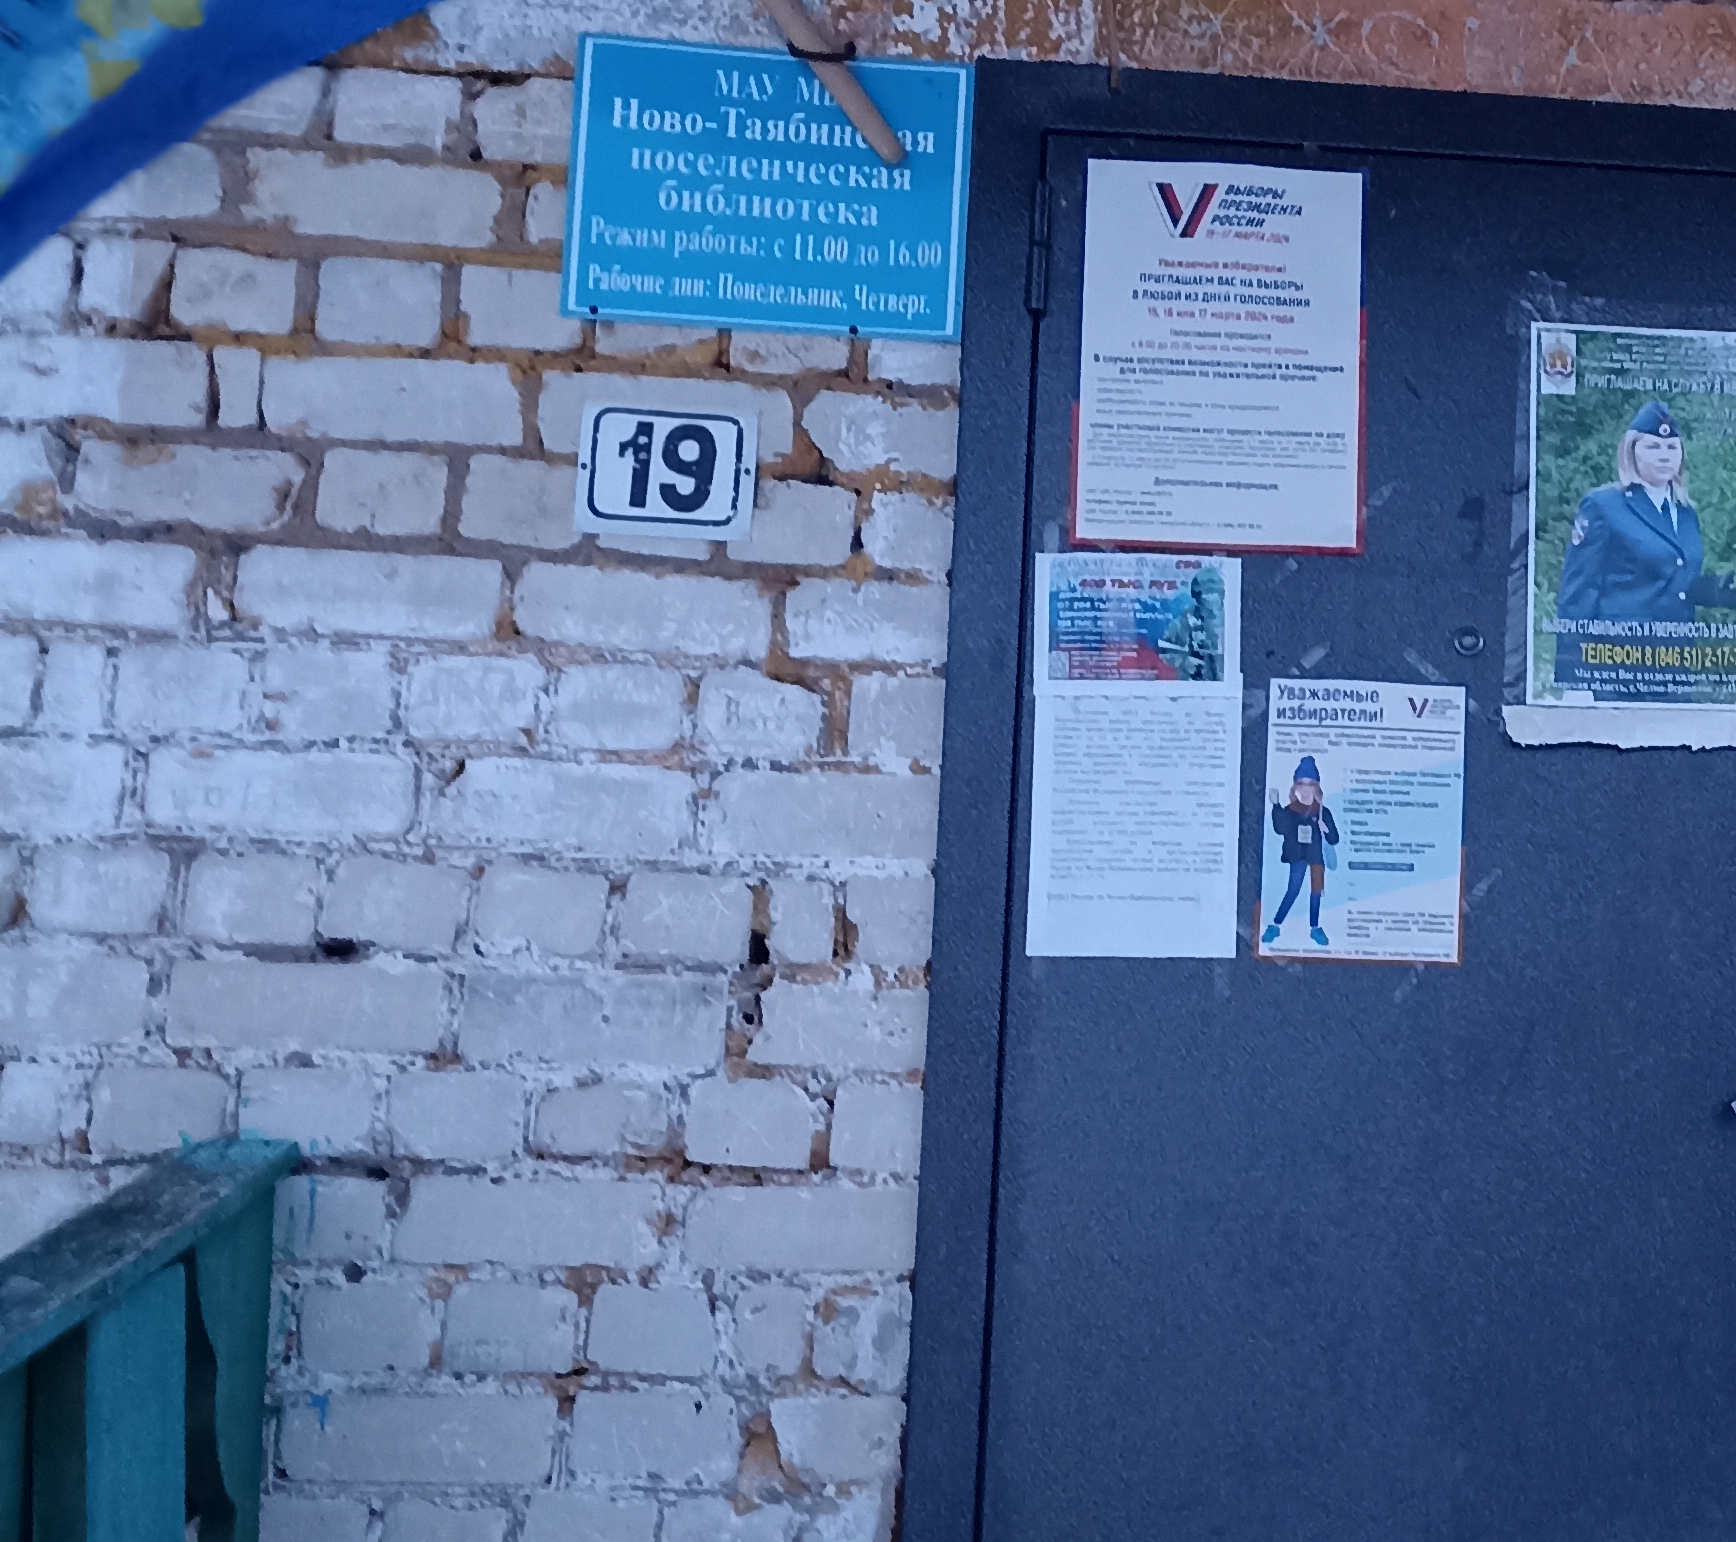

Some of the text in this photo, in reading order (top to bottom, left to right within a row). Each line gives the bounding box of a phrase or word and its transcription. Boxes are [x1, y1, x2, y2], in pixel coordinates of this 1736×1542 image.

[714, 70, 779, 102] МАУ
[612, 96, 935, 154] Ново-Таябинсая
[631, 146, 911, 191] поселенческая
[659, 179, 880, 227] библиотека
[1224, 184, 1286, 200] ВЫБОРЫ
[1218, 199, 1303, 217] ПРЕЗИДЕНТА
[1210, 215, 1266, 229] РОССИИ
[590, 215, 942, 268] Режим работы: с 11.00 до 16.00
[588, 263, 663, 296] Рабочие
[669, 274, 711, 297] дни:
[855, 285, 931, 320] Четверг.
[1140, 273, 1214, 286] ПРИГЛАШАЕМ
[1218, 276, 1237, 287] ВАС
[1256, 280, 1304, 291] ВЫБОРЫ
[1142, 289, 1181, 301] ЛЮБОЙ
[1234, 293, 1310, 307] ГОЛОСОВАНИЯ
[619, 421, 717, 513] 19
[1580, 643, 1642, 665] ТЕЛЕФОН
[1645, 646, 1652, 666] 8
[1277, 684, 1379, 703] Уважаемые
[1276, 704, 1384, 725] избиратели!
